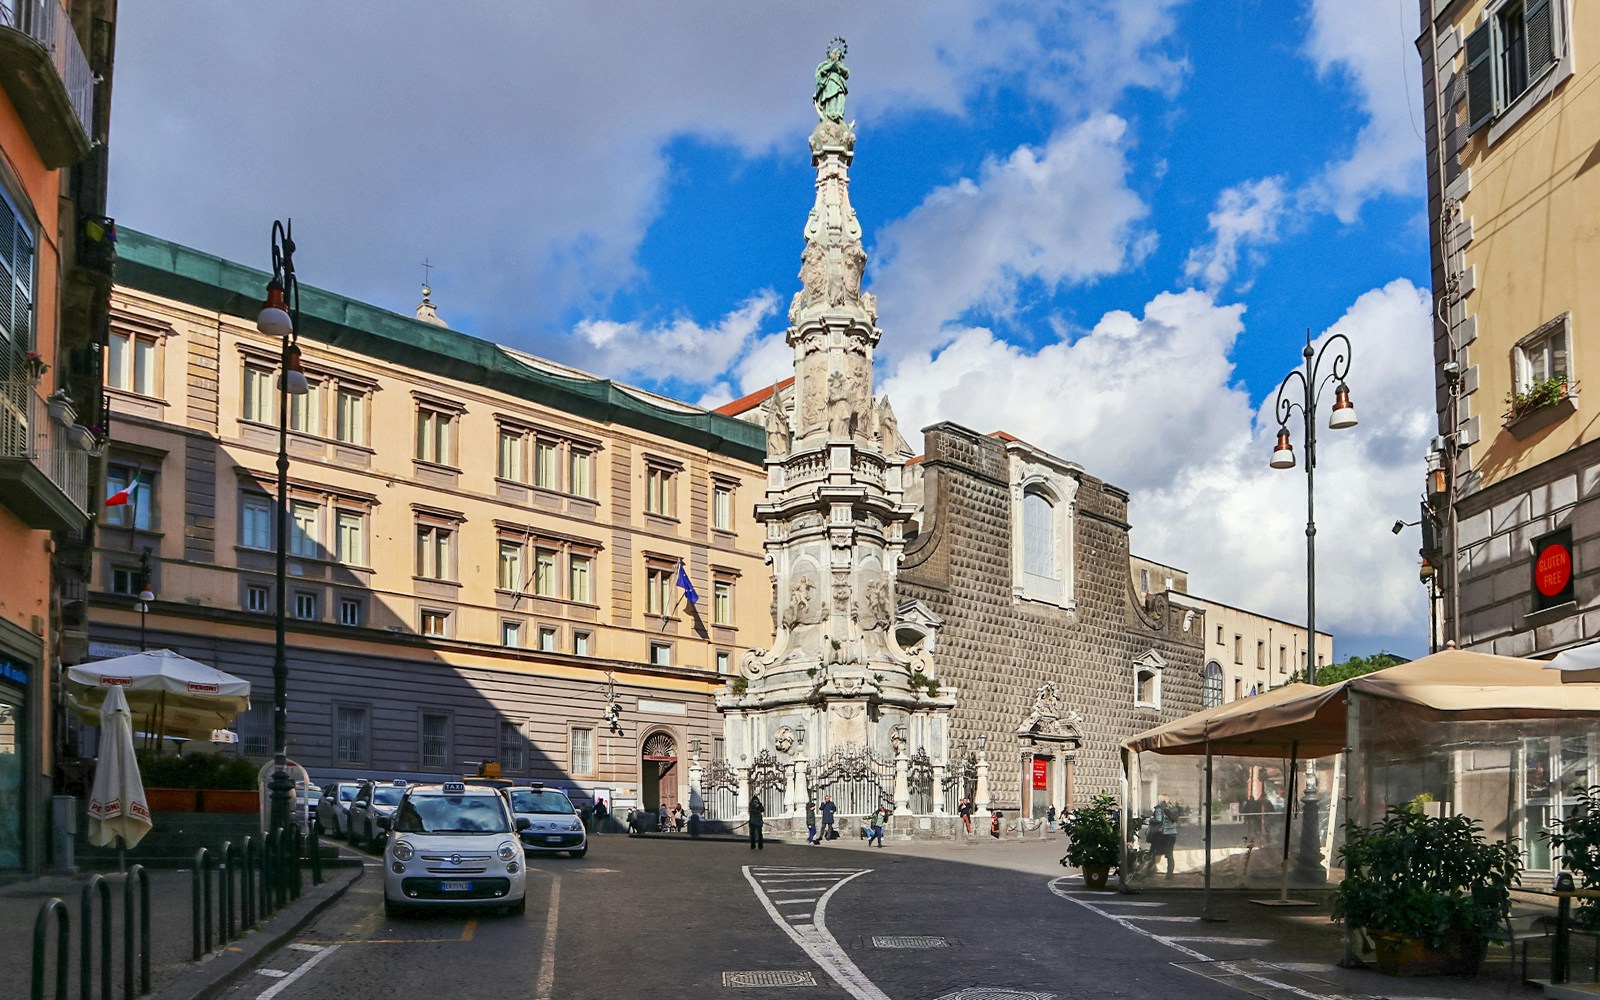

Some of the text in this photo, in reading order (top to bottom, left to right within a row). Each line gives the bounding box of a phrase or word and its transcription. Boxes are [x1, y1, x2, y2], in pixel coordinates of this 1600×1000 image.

[1539, 553, 1566, 572] GLUTEN
[1544, 571, 1561, 587] FREE
[102, 677, 131, 686] PERONI
[189, 683, 217, 692] PERONI
